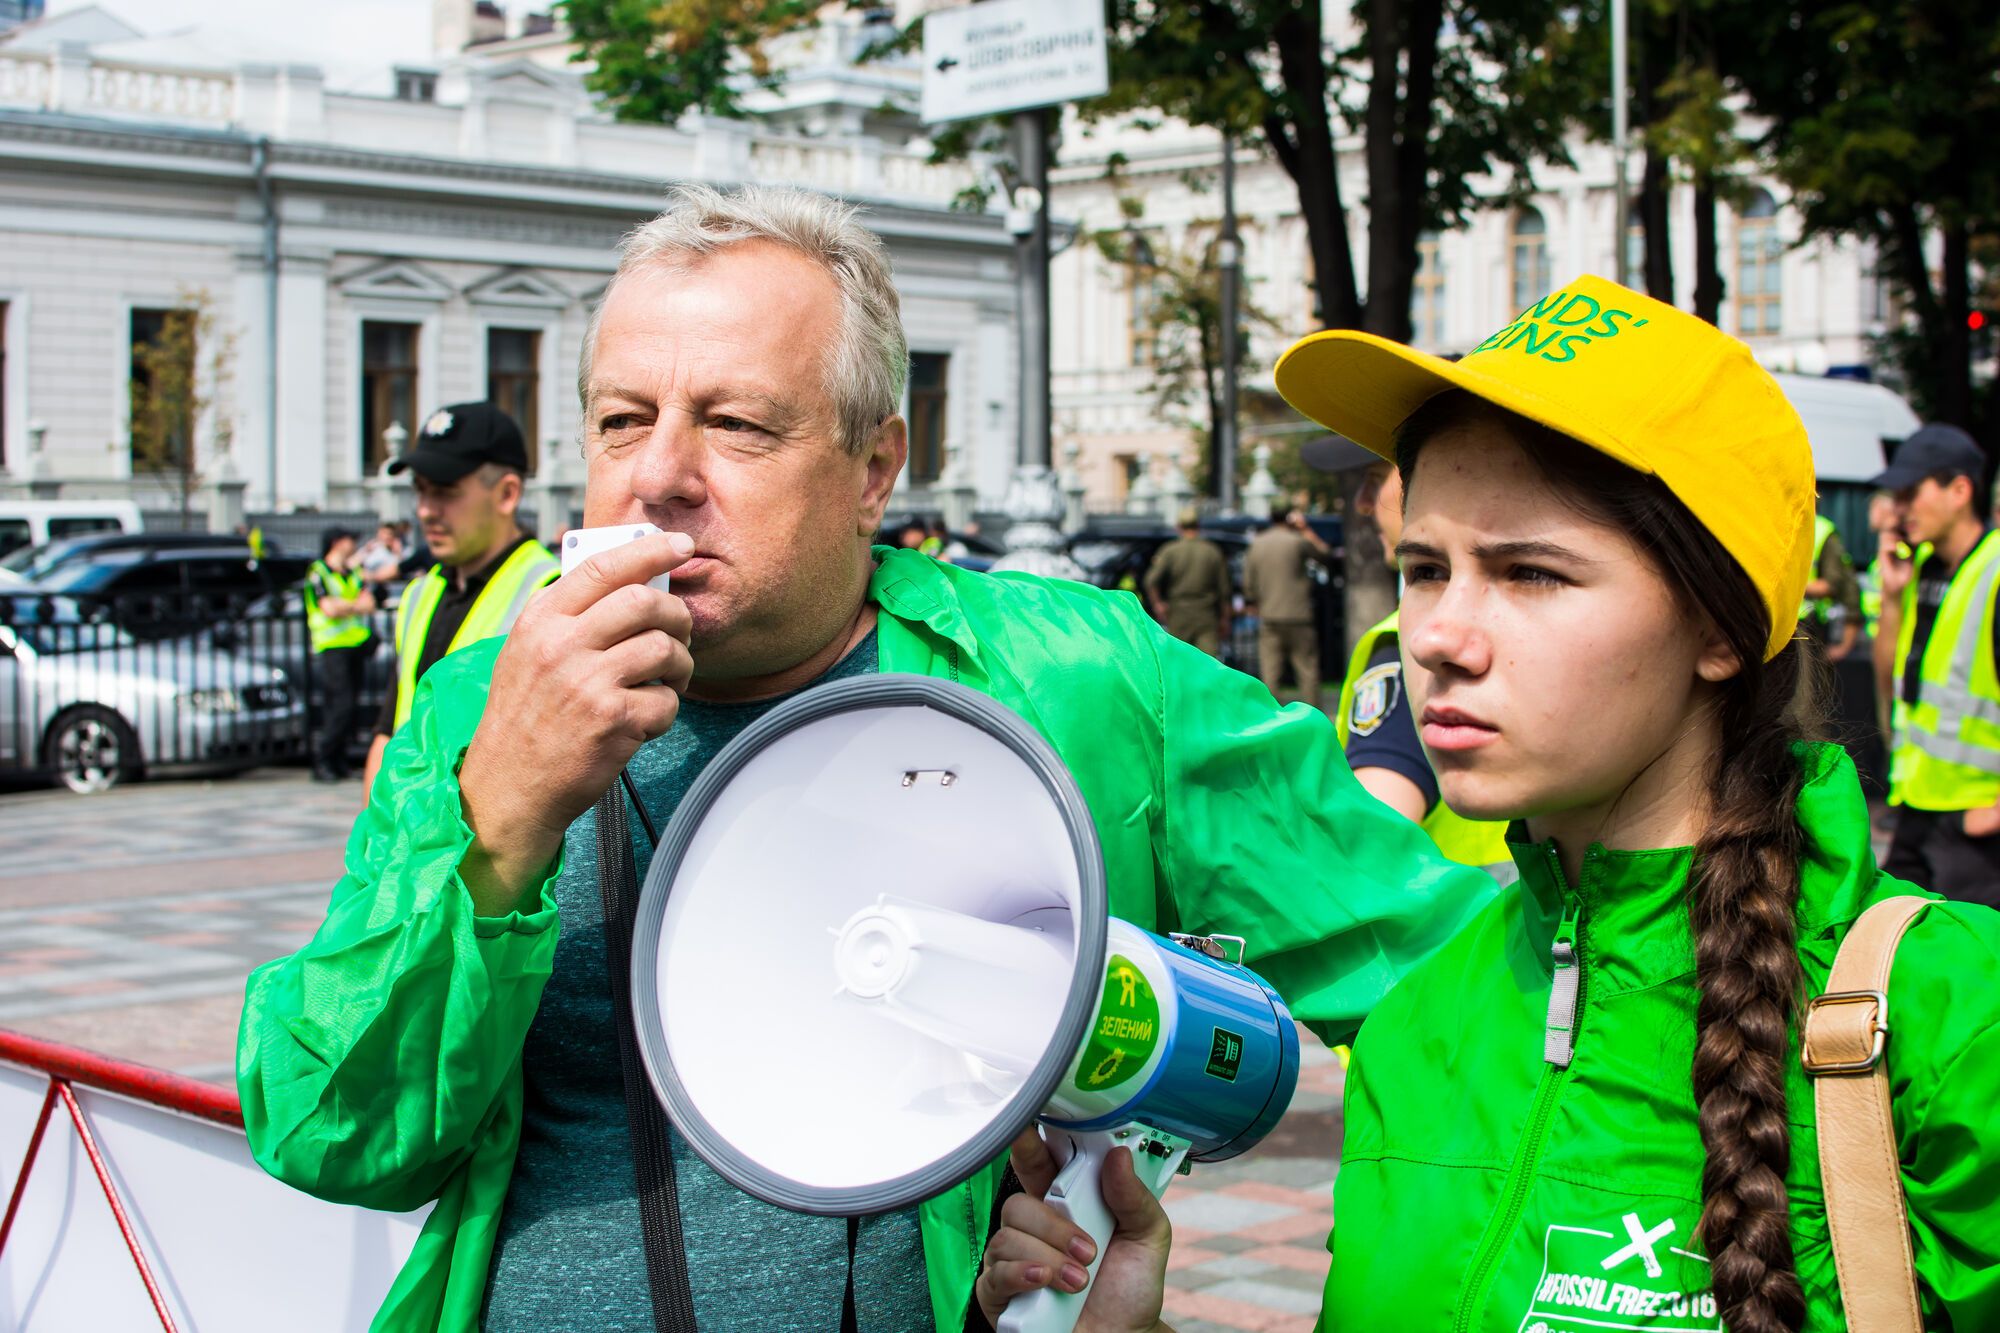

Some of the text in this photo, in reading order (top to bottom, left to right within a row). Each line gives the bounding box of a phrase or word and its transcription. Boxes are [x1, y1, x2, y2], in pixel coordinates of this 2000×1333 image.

[1118, 966, 1136, 1008] Я
[1099, 1016, 1153, 1042] ЗЕЛЕНИЙ
[1150, 1129, 1171, 1142] ON OFF
[1536, 1272, 1718, 1318] #FOSSILFREE2016
